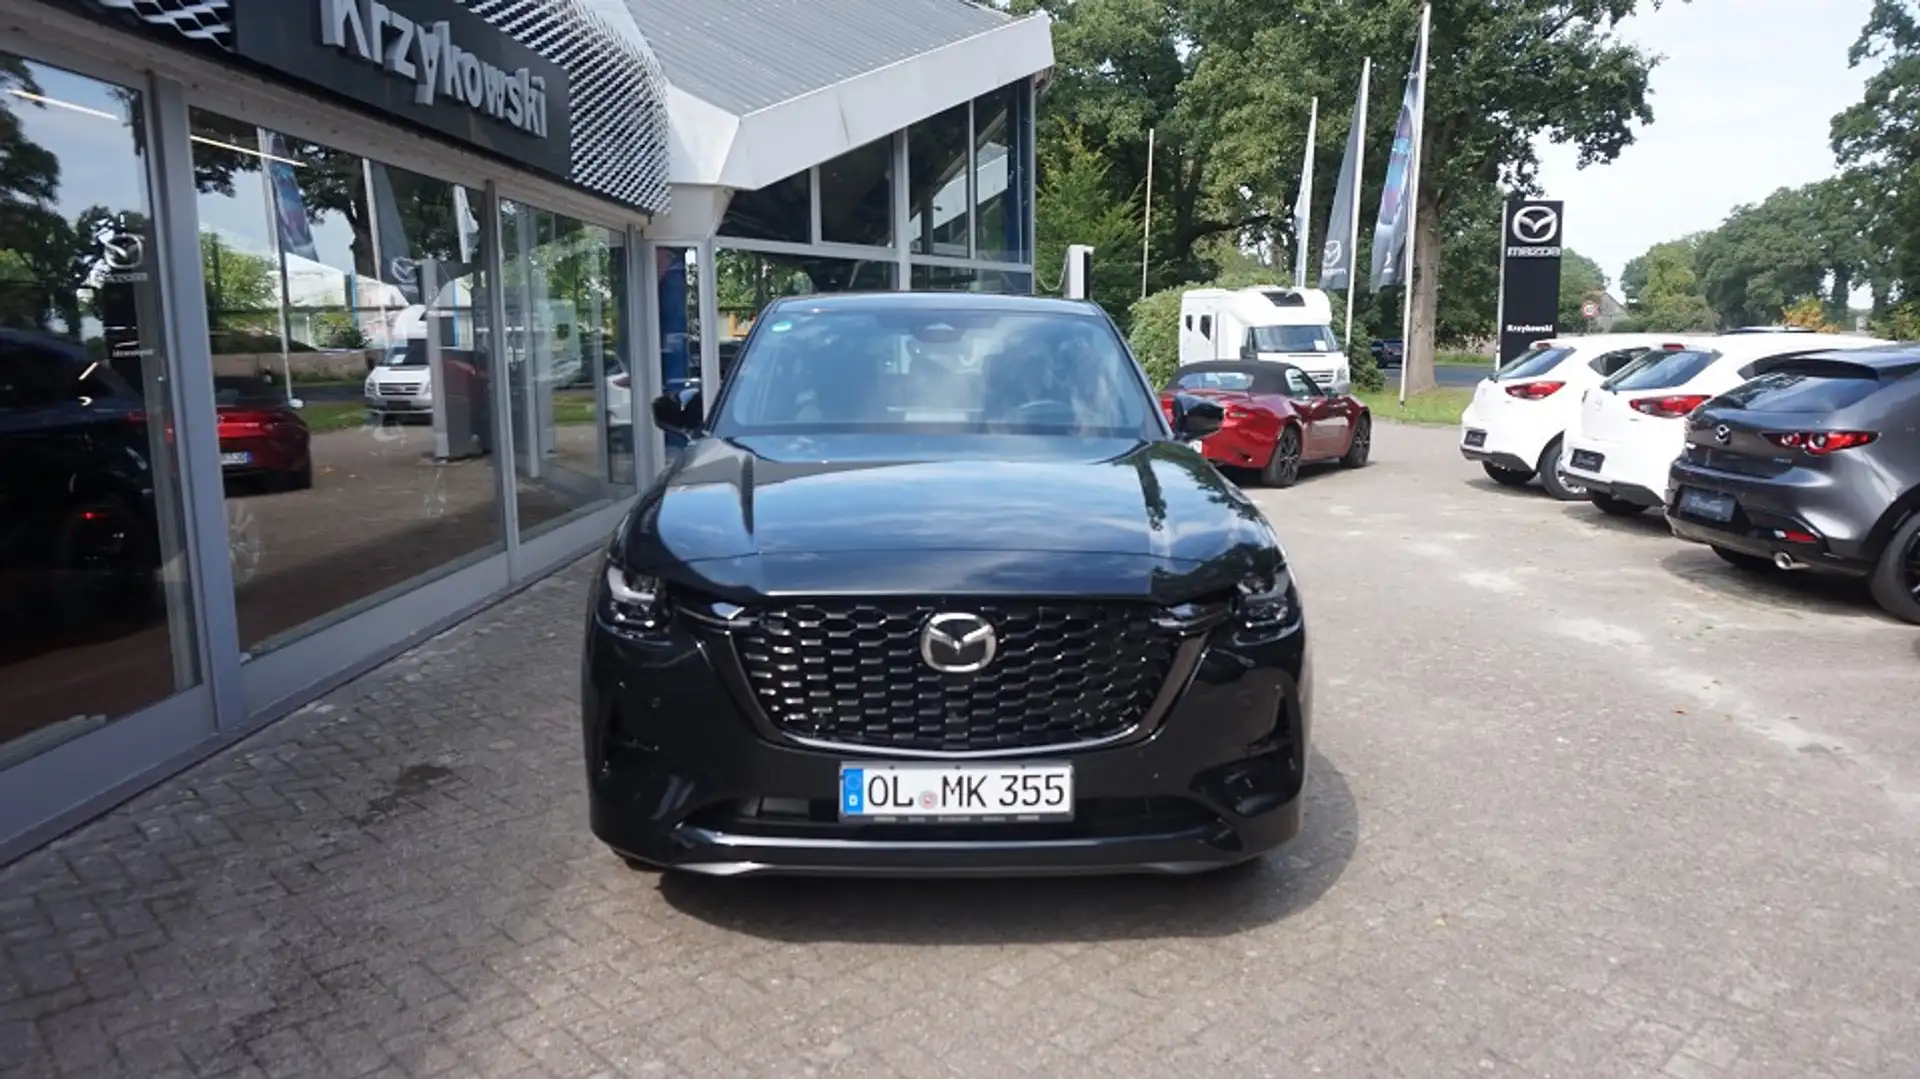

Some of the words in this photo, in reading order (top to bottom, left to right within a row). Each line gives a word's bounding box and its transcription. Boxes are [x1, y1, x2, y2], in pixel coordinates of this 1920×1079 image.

[321, 0, 548, 138] Krzykowski
[868, 775, 914, 807] OL
[942, 775, 988, 807] MK
[999, 774, 1065, 806] 355
